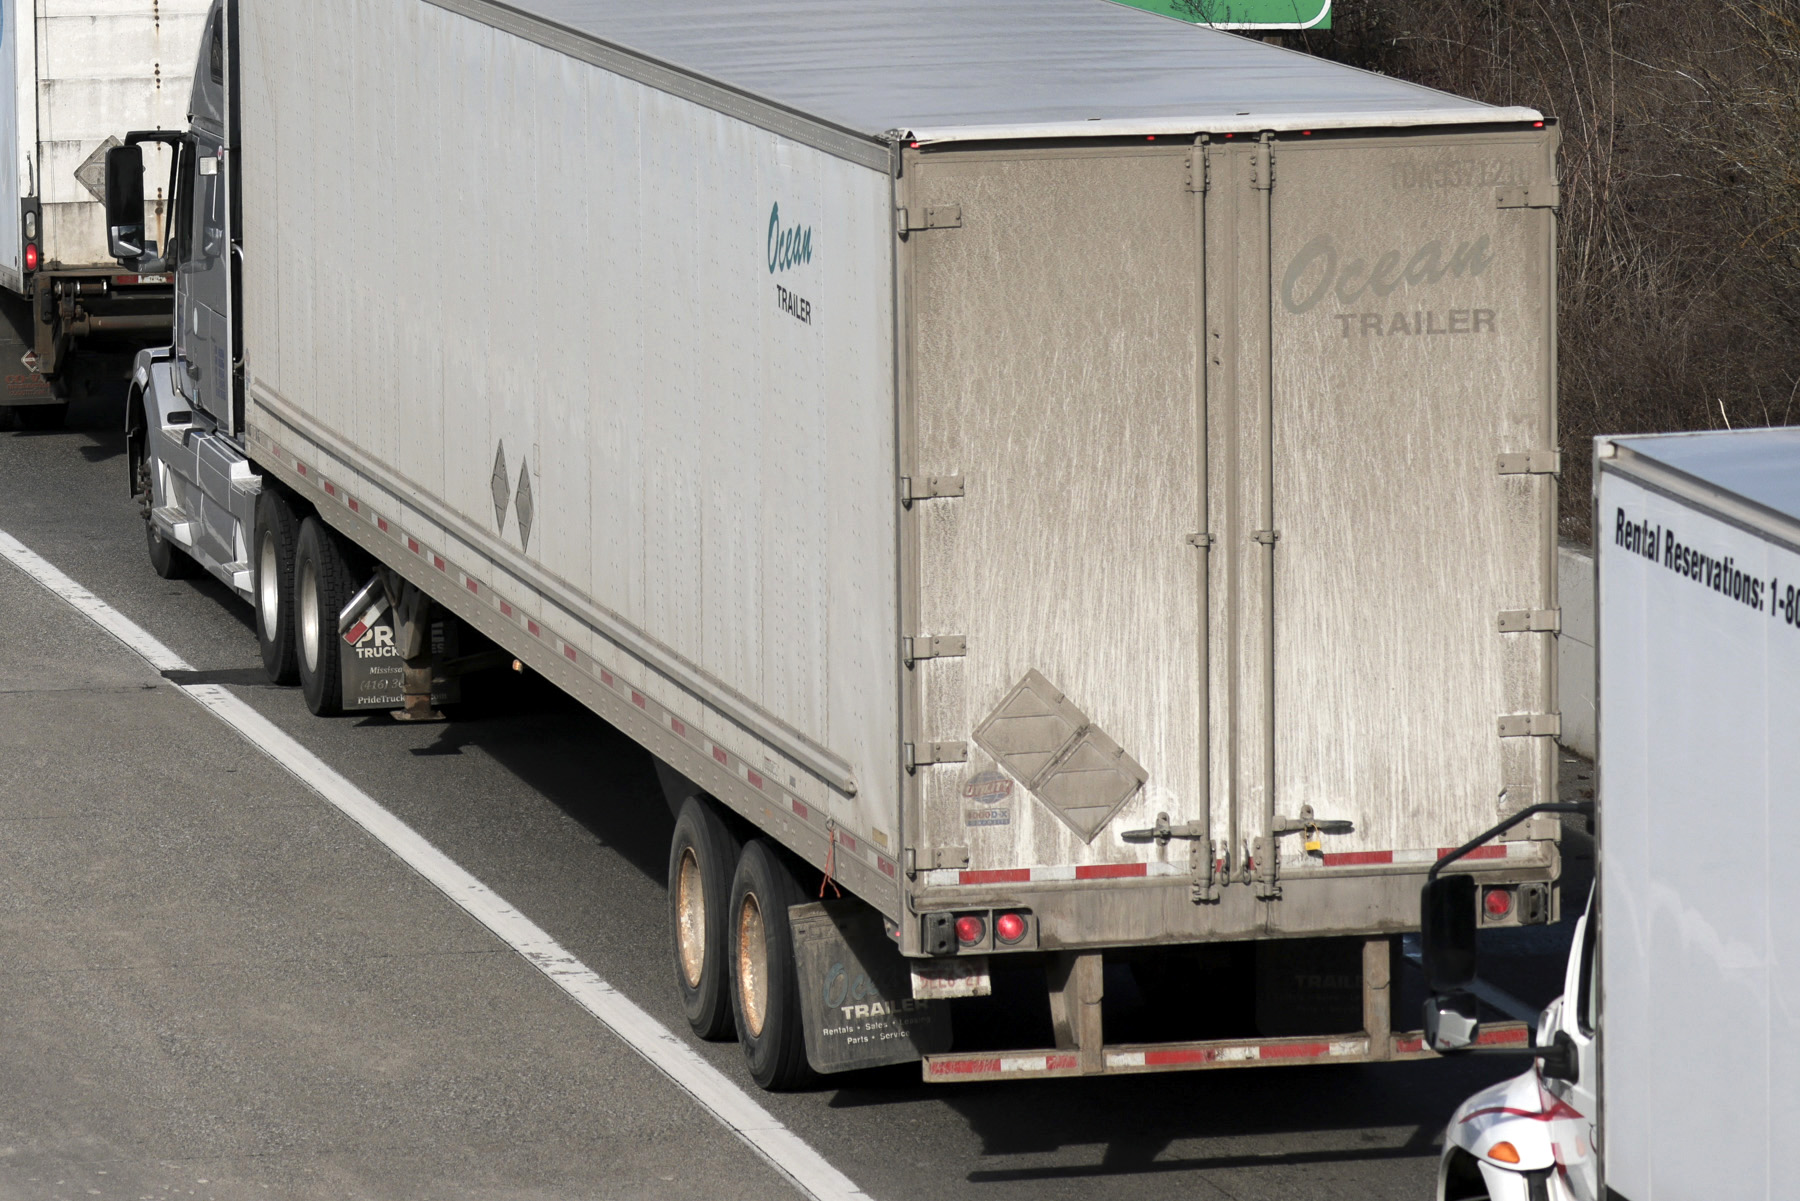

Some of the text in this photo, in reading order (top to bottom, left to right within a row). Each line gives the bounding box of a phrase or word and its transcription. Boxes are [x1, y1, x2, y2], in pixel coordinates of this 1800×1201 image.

[767, 201, 812, 274] Ocean
[1281, 233, 1496, 315] Ocean
[776, 284, 811, 325] TRAILER
[1334, 308, 1497, 338] TRAILER
[1615, 506, 1661, 563] Rental
[1664, 529, 1764, 611] Reservations:
[356, 646, 400, 658] TRUCK
[369, 666, 403, 675] Mississa
[841, 998, 929, 1020] TRAILER
[823, 1026, 854, 1036] Rentals
[865, 1022, 888, 1031] Sales
[847, 1030, 911, 1045] Parts Service
